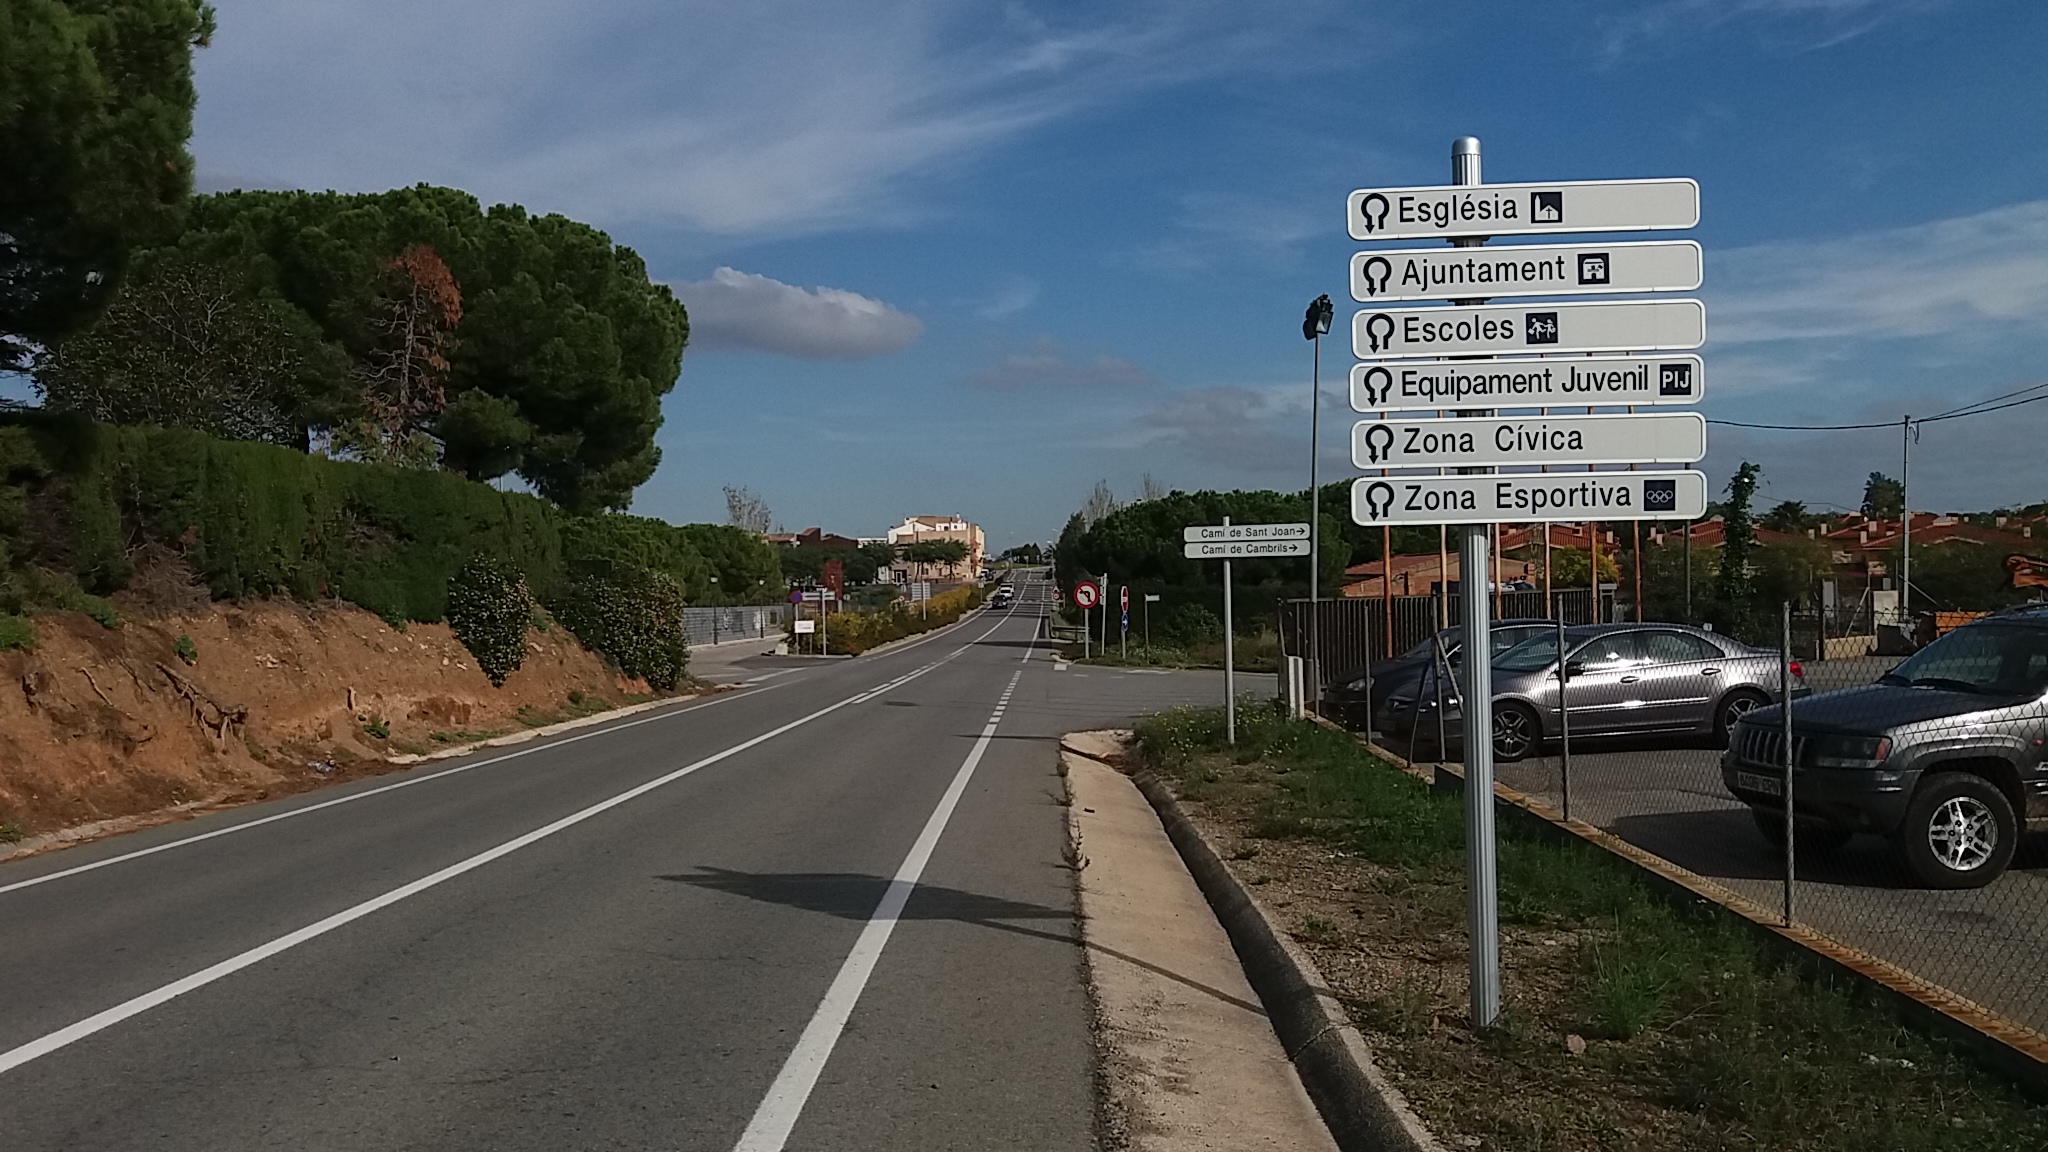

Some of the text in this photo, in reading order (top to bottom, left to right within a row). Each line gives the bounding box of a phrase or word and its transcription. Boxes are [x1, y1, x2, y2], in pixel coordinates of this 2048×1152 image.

[1399, 194, 1518, 228] Església
[1402, 256, 1565, 291] Ajuntament
[1404, 314, 1514, 343] Escoles
[1401, 365, 1648, 402] Equipament Juvenil
[1662, 370, 1690, 388] PIJ
[1404, 424, 1583, 454] Zona Cívica
[1404, 481, 1631, 514] Zona Esportiva
[1201, 527, 1295, 538] Camí de Sant Joan
[1202, 545, 1226, 554] Camí
[1246, 544, 1288, 553] Cambrils
